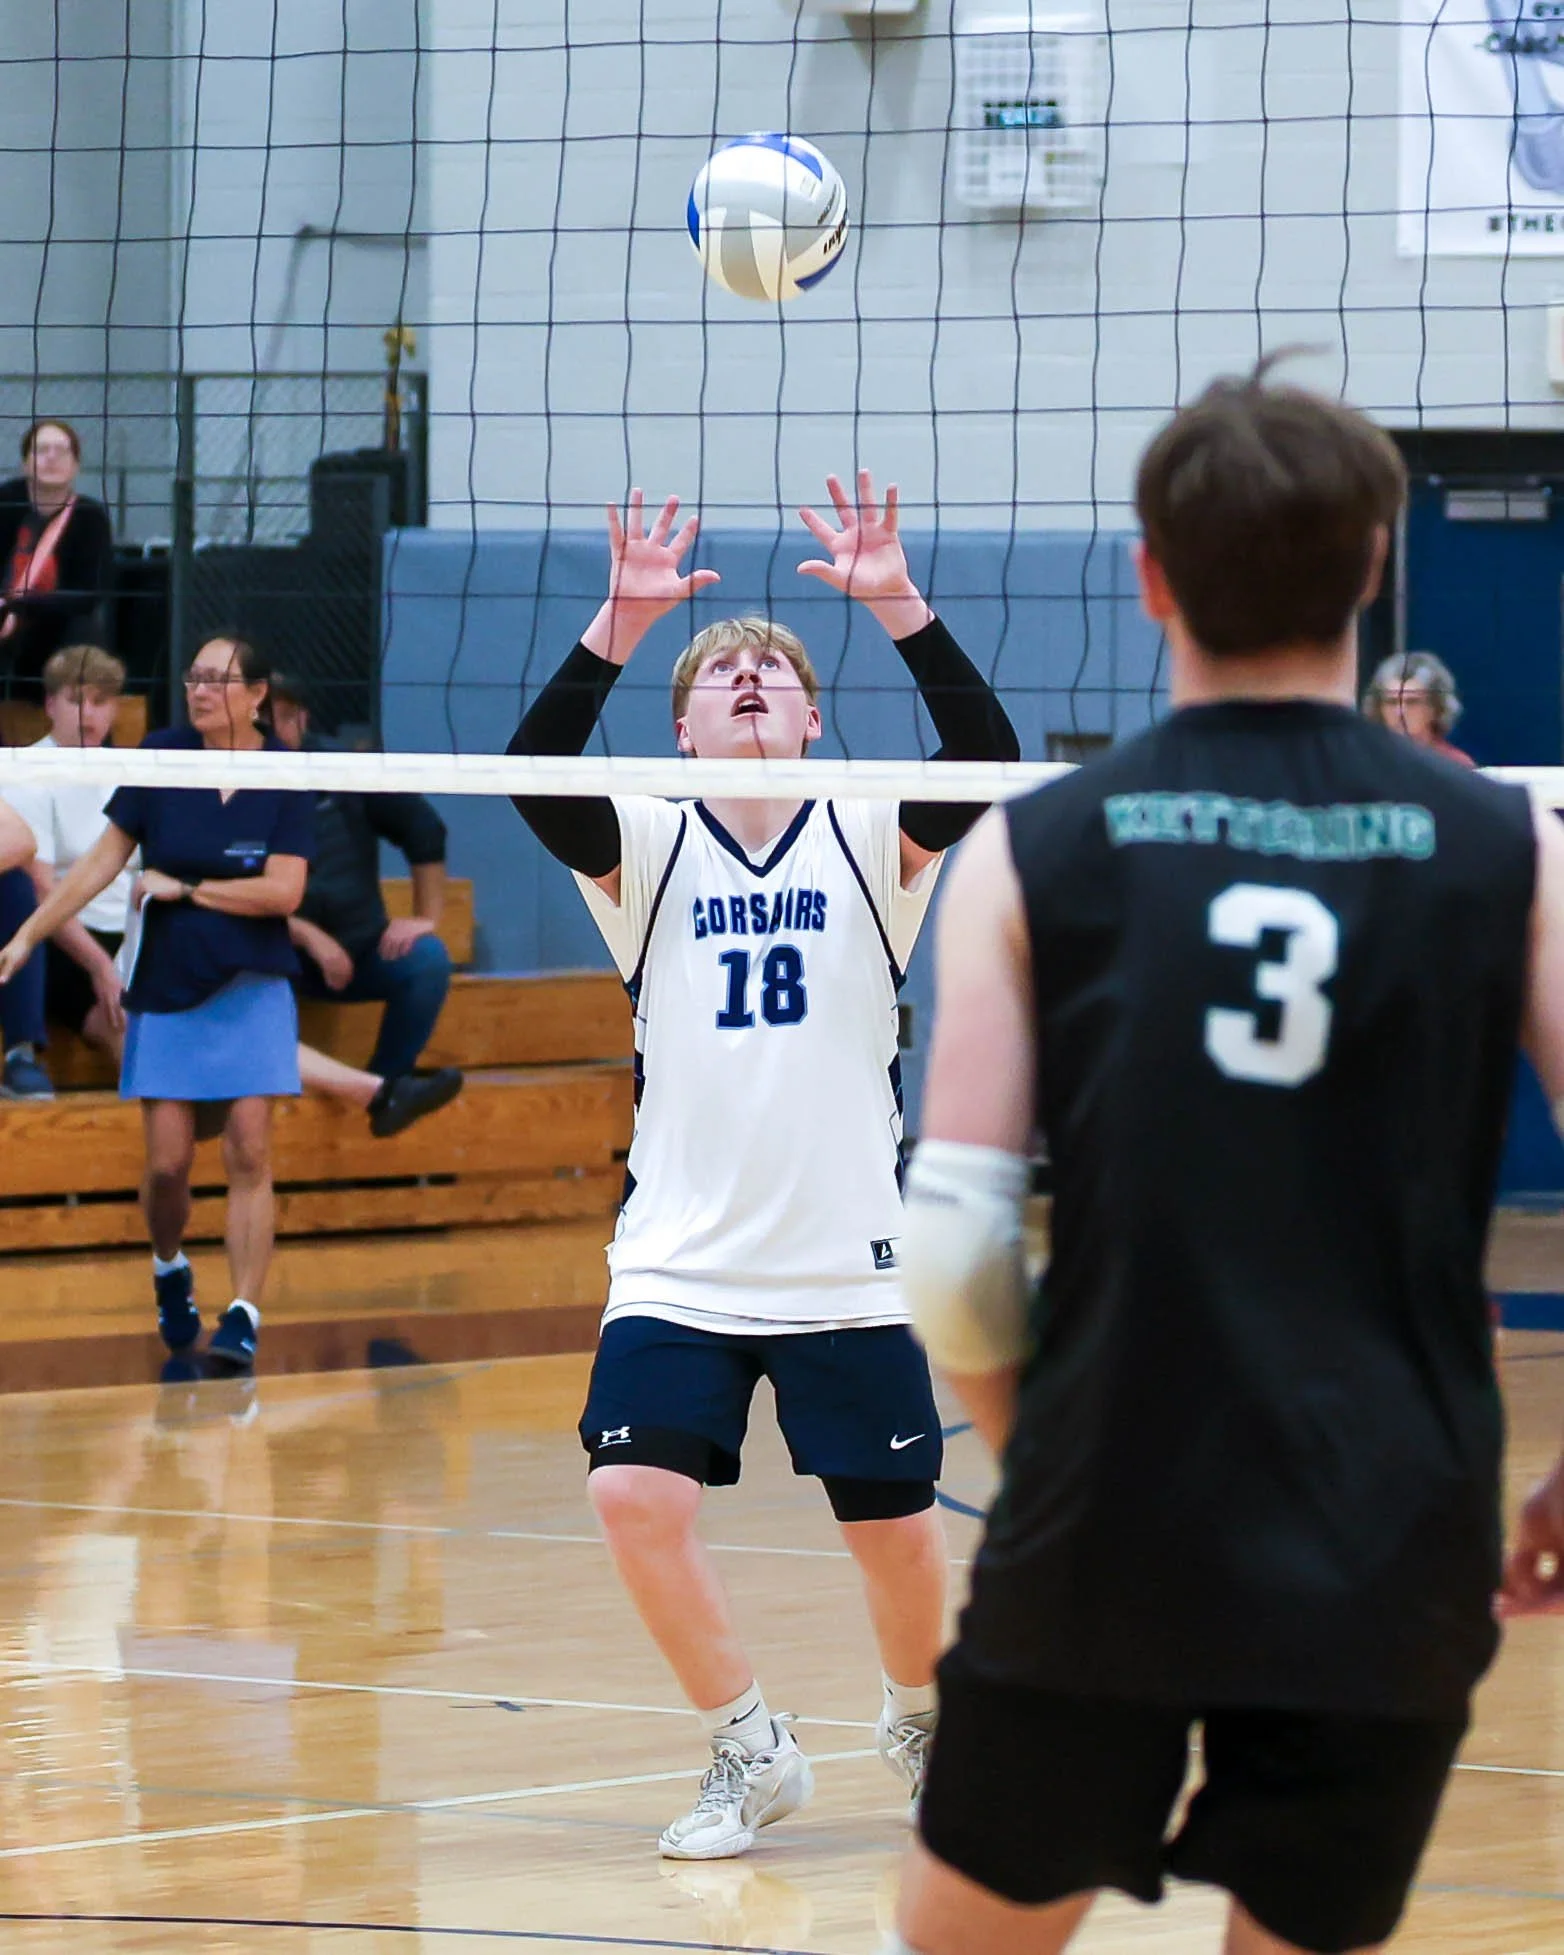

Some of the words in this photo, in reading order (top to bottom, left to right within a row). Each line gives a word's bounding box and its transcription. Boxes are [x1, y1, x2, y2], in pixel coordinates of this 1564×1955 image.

[692, 887, 828, 940] CORSAIRS
[716, 944, 808, 1030] 18
[1205, 882, 1339, 1088] 3
